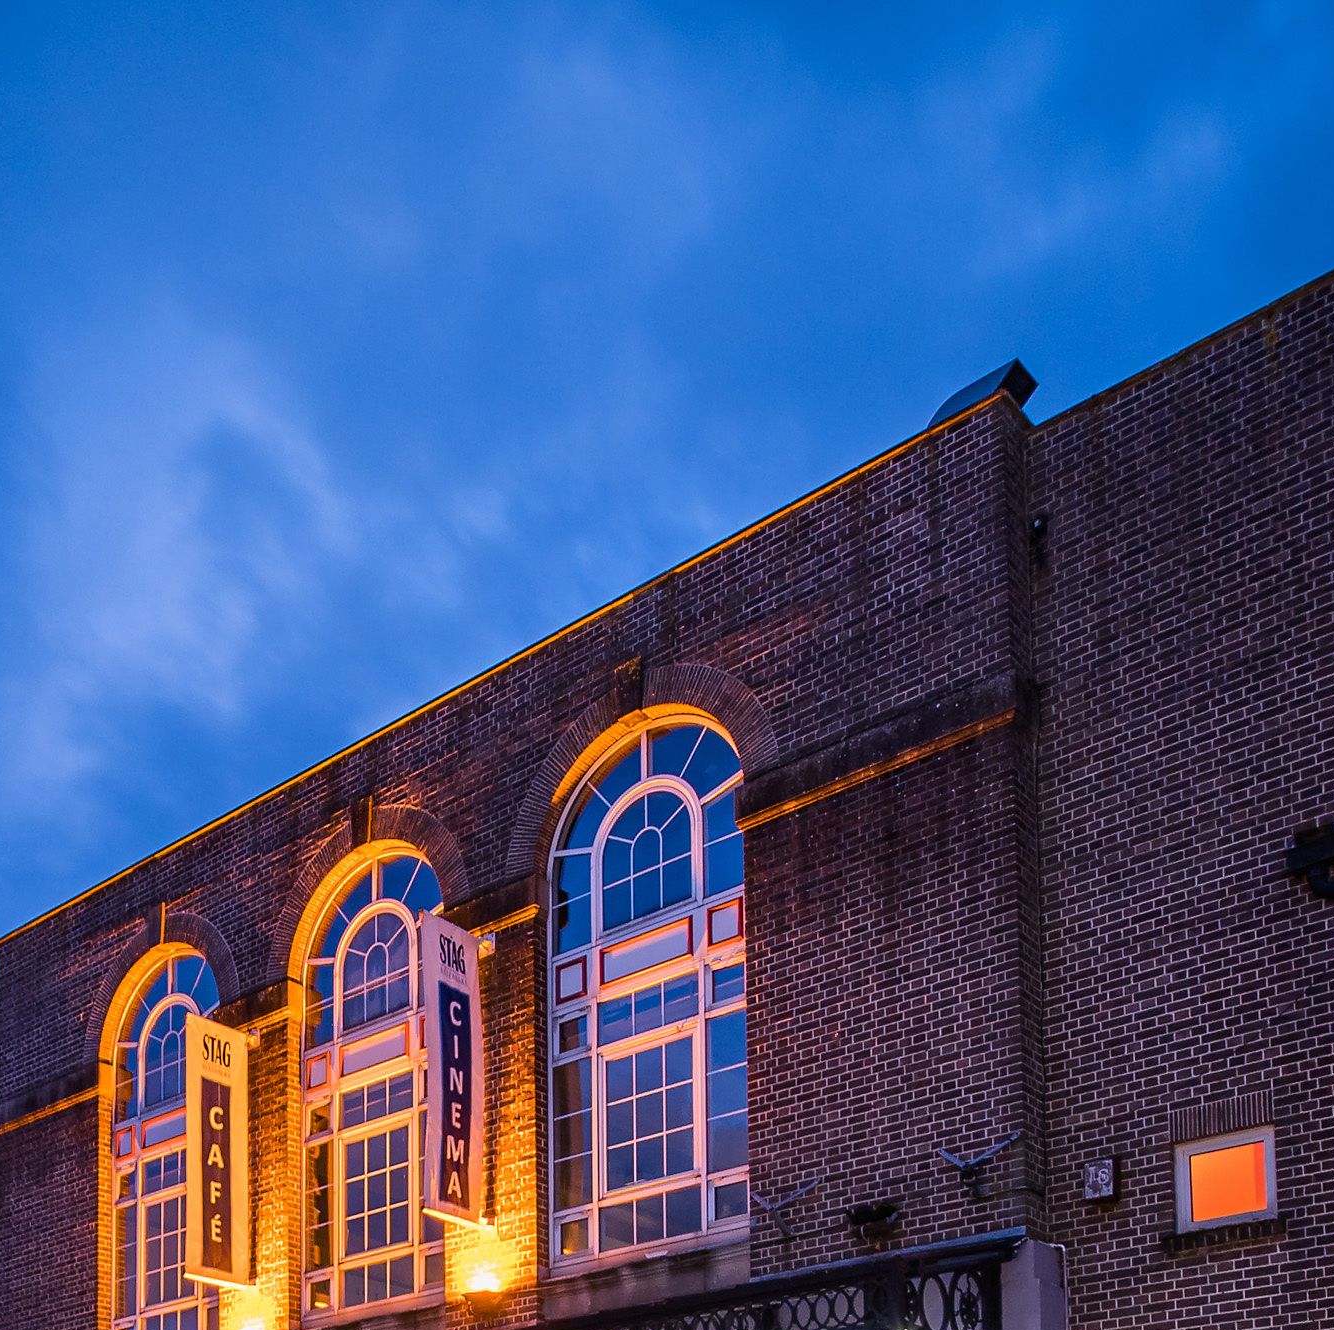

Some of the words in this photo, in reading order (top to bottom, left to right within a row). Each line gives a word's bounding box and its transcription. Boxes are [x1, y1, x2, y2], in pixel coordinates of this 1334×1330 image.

[439, 933, 466, 975] STAG
[202, 1033, 231, 1068] STAG
[446, 1001, 464, 1199] CINEMA
[207, 1106, 224, 1243] CAFÉ
